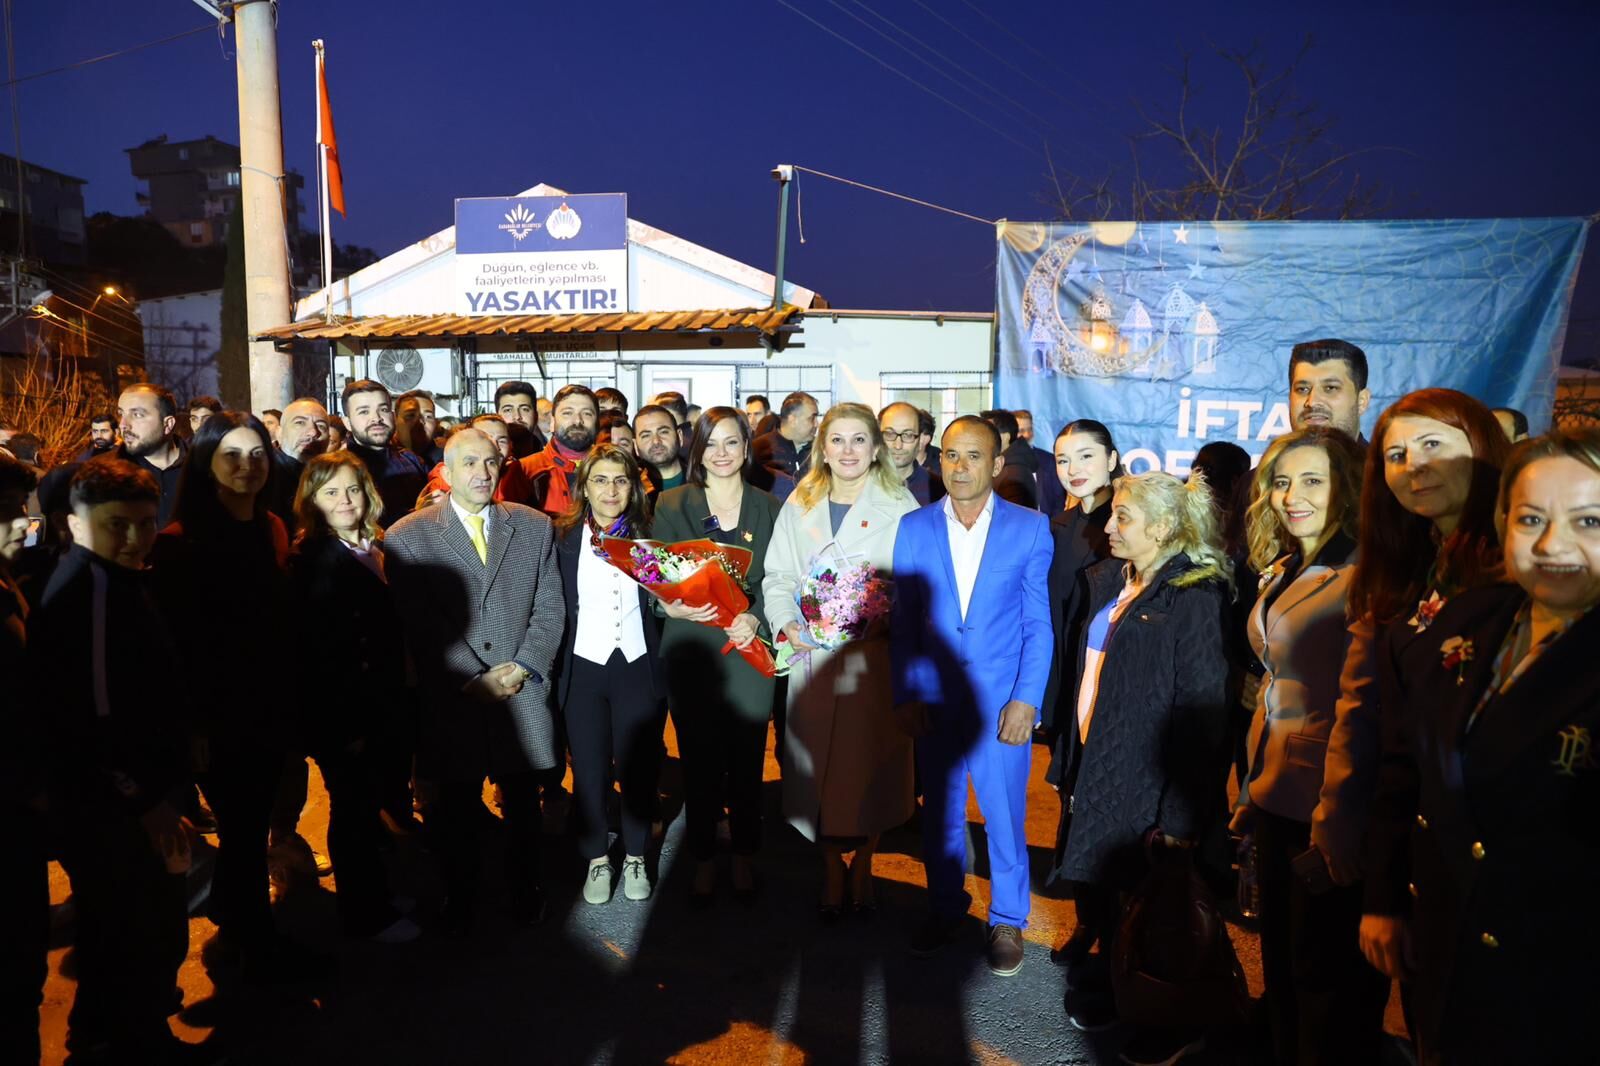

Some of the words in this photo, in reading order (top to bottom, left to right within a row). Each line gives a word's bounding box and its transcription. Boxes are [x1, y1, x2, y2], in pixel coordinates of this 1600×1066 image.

[581, 261, 599, 271] vb.
[475, 275, 545, 287] faaliyetlerin
[548, 274, 606, 286] yapılması
[465, 288, 617, 312] YASAKTIR!
[1177, 387, 1293, 441] İFTA
